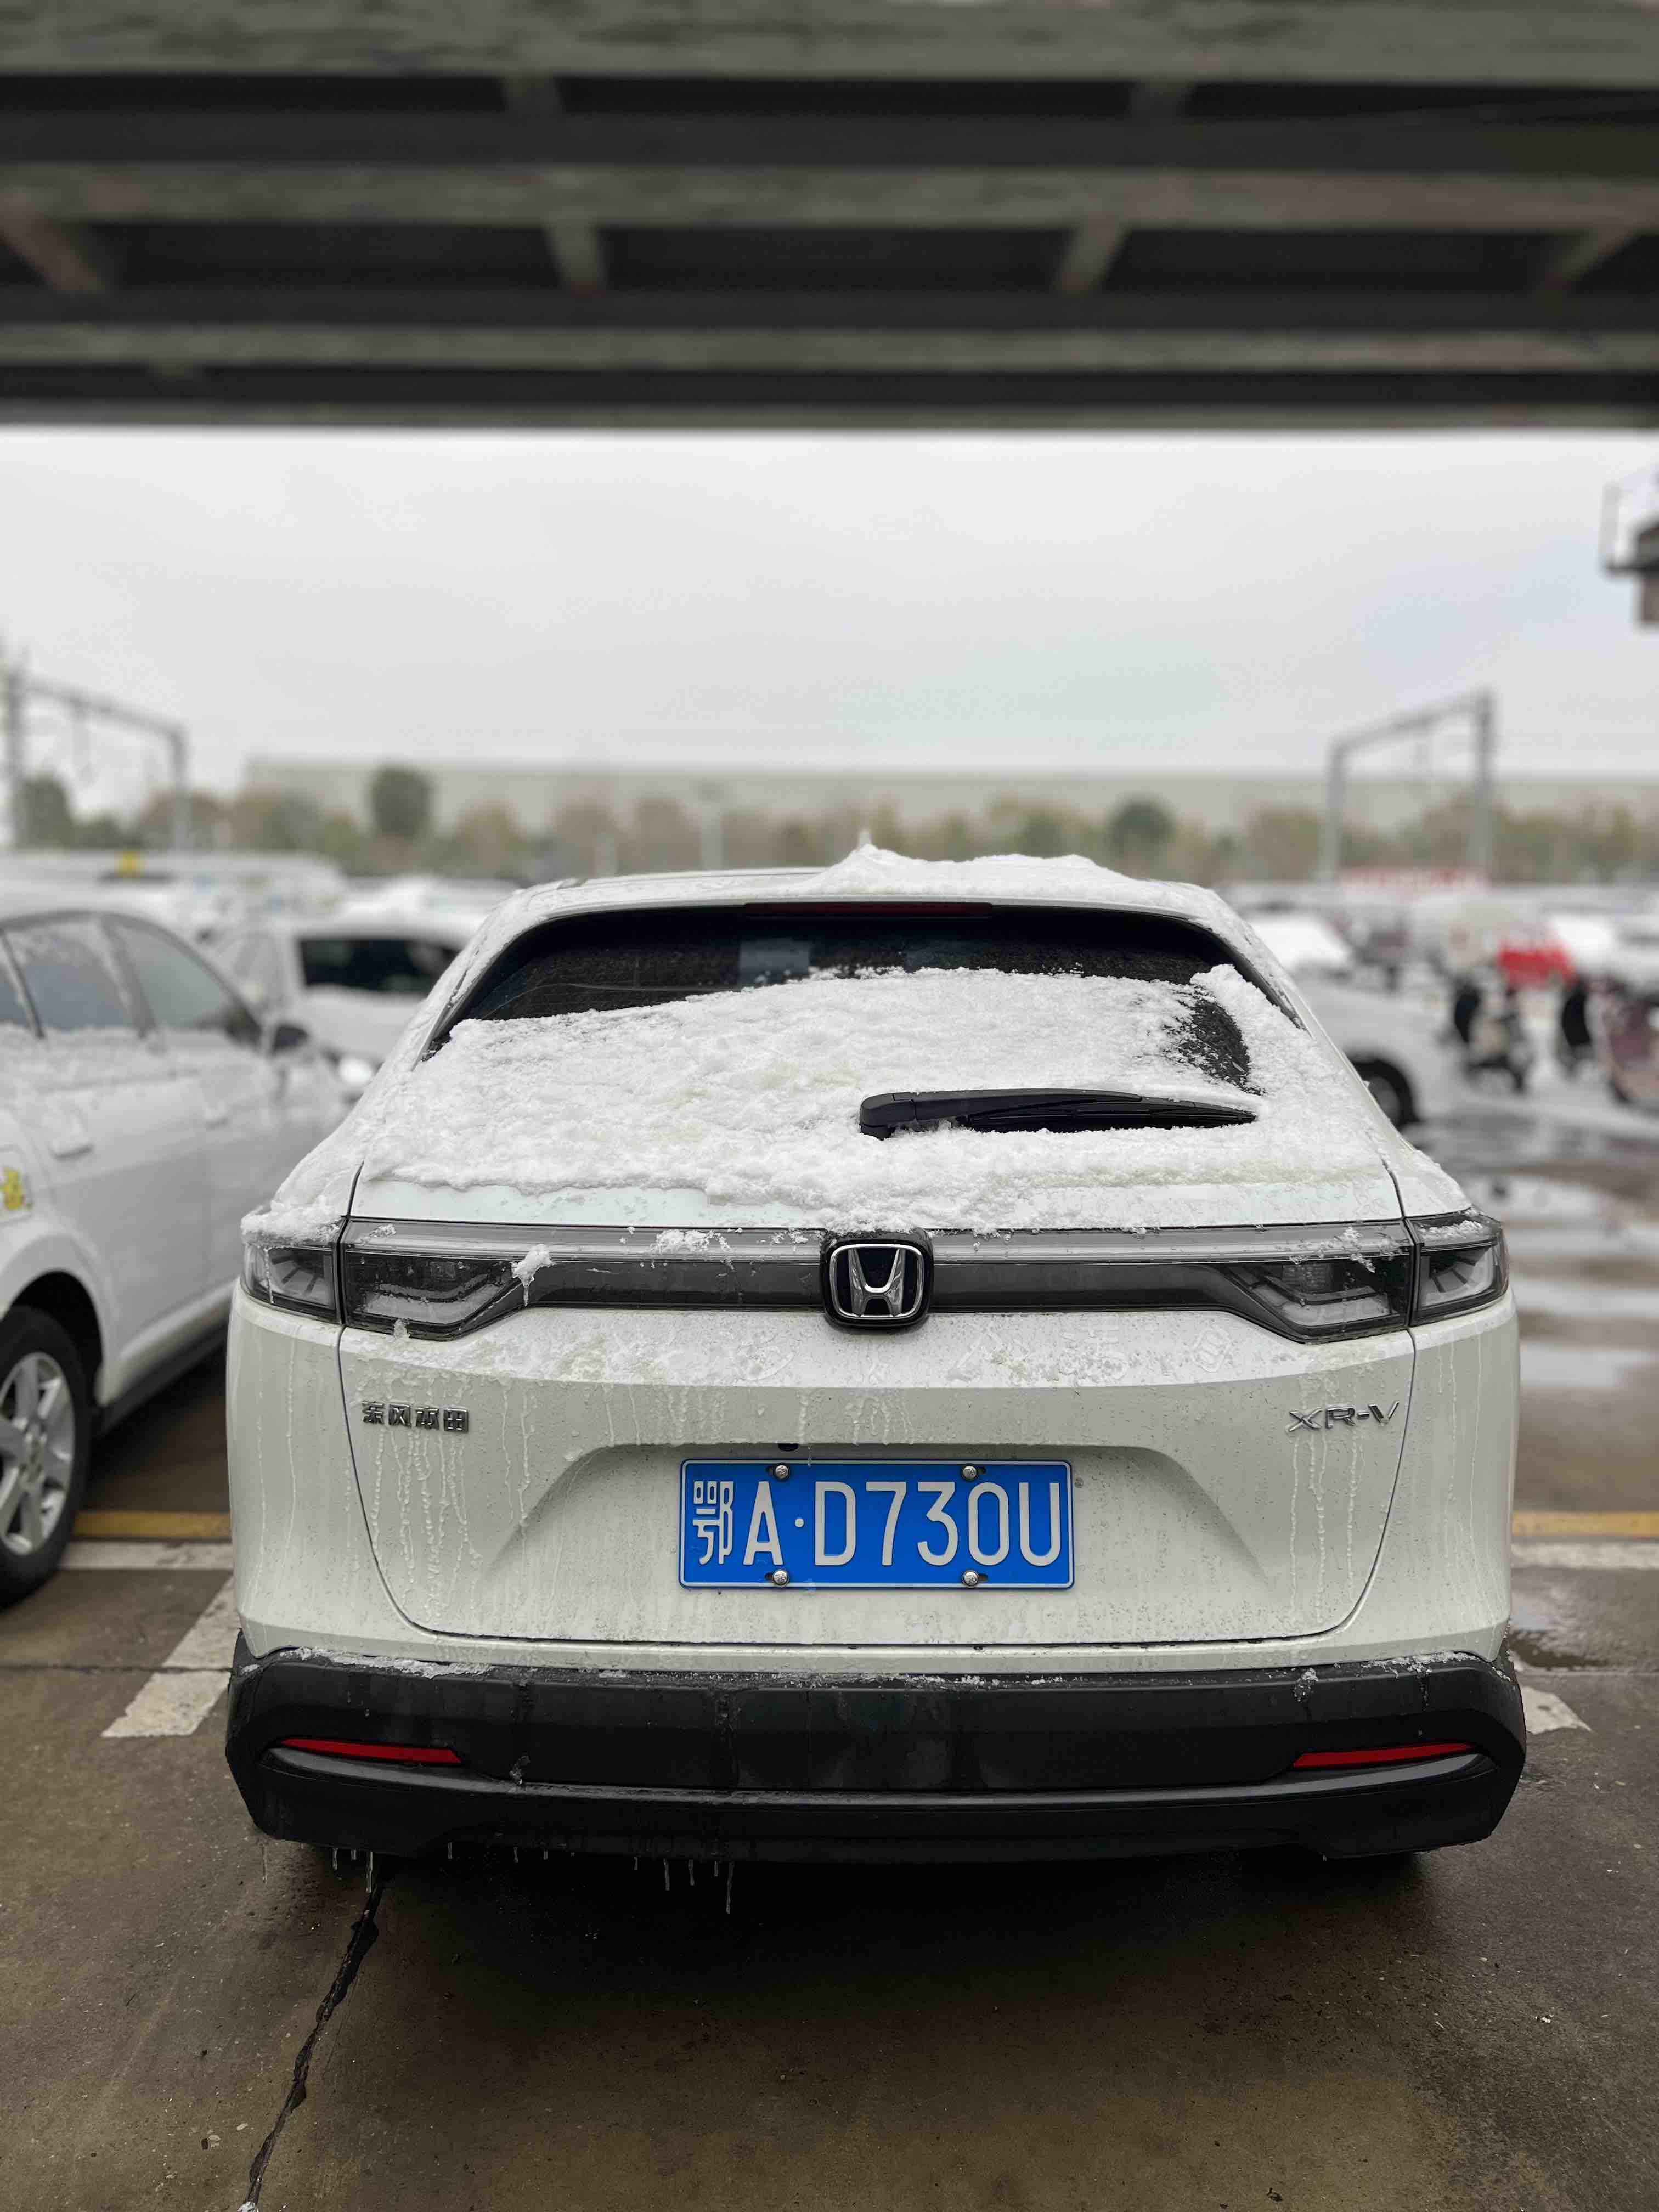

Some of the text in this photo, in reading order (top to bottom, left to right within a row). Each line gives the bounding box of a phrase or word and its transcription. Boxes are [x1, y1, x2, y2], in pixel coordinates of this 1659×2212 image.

[362, 1401, 469, 1432] 东风本田
[1288, 1401, 1400, 1432] XR-V
